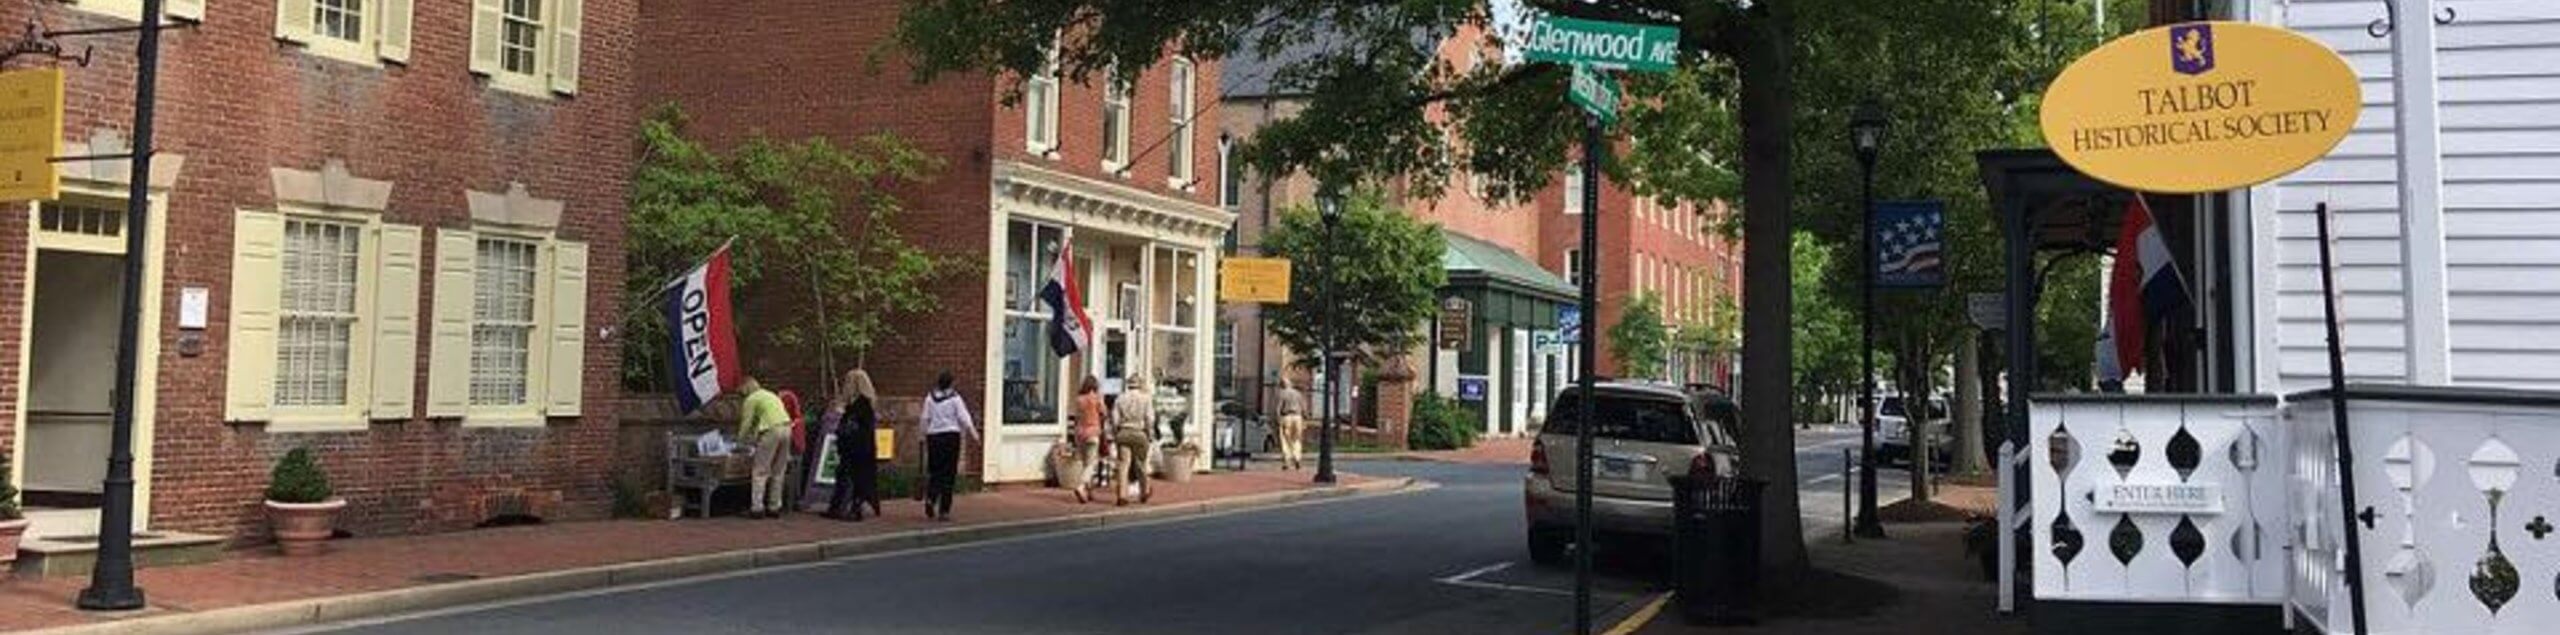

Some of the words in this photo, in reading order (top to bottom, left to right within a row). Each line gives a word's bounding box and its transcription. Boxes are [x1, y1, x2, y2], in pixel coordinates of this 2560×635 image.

[1534, 21, 1645, 60] Glenwood
[1650, 40, 1678, 65] AVE
[2139, 81, 2254, 115] TALBOT
[2072, 119, 2219, 151] HISTORICAL
[2223, 109, 2331, 138] SOCIETY
[684, 290, 712, 378] OPEN
[2113, 485, 2163, 500] ENTER
